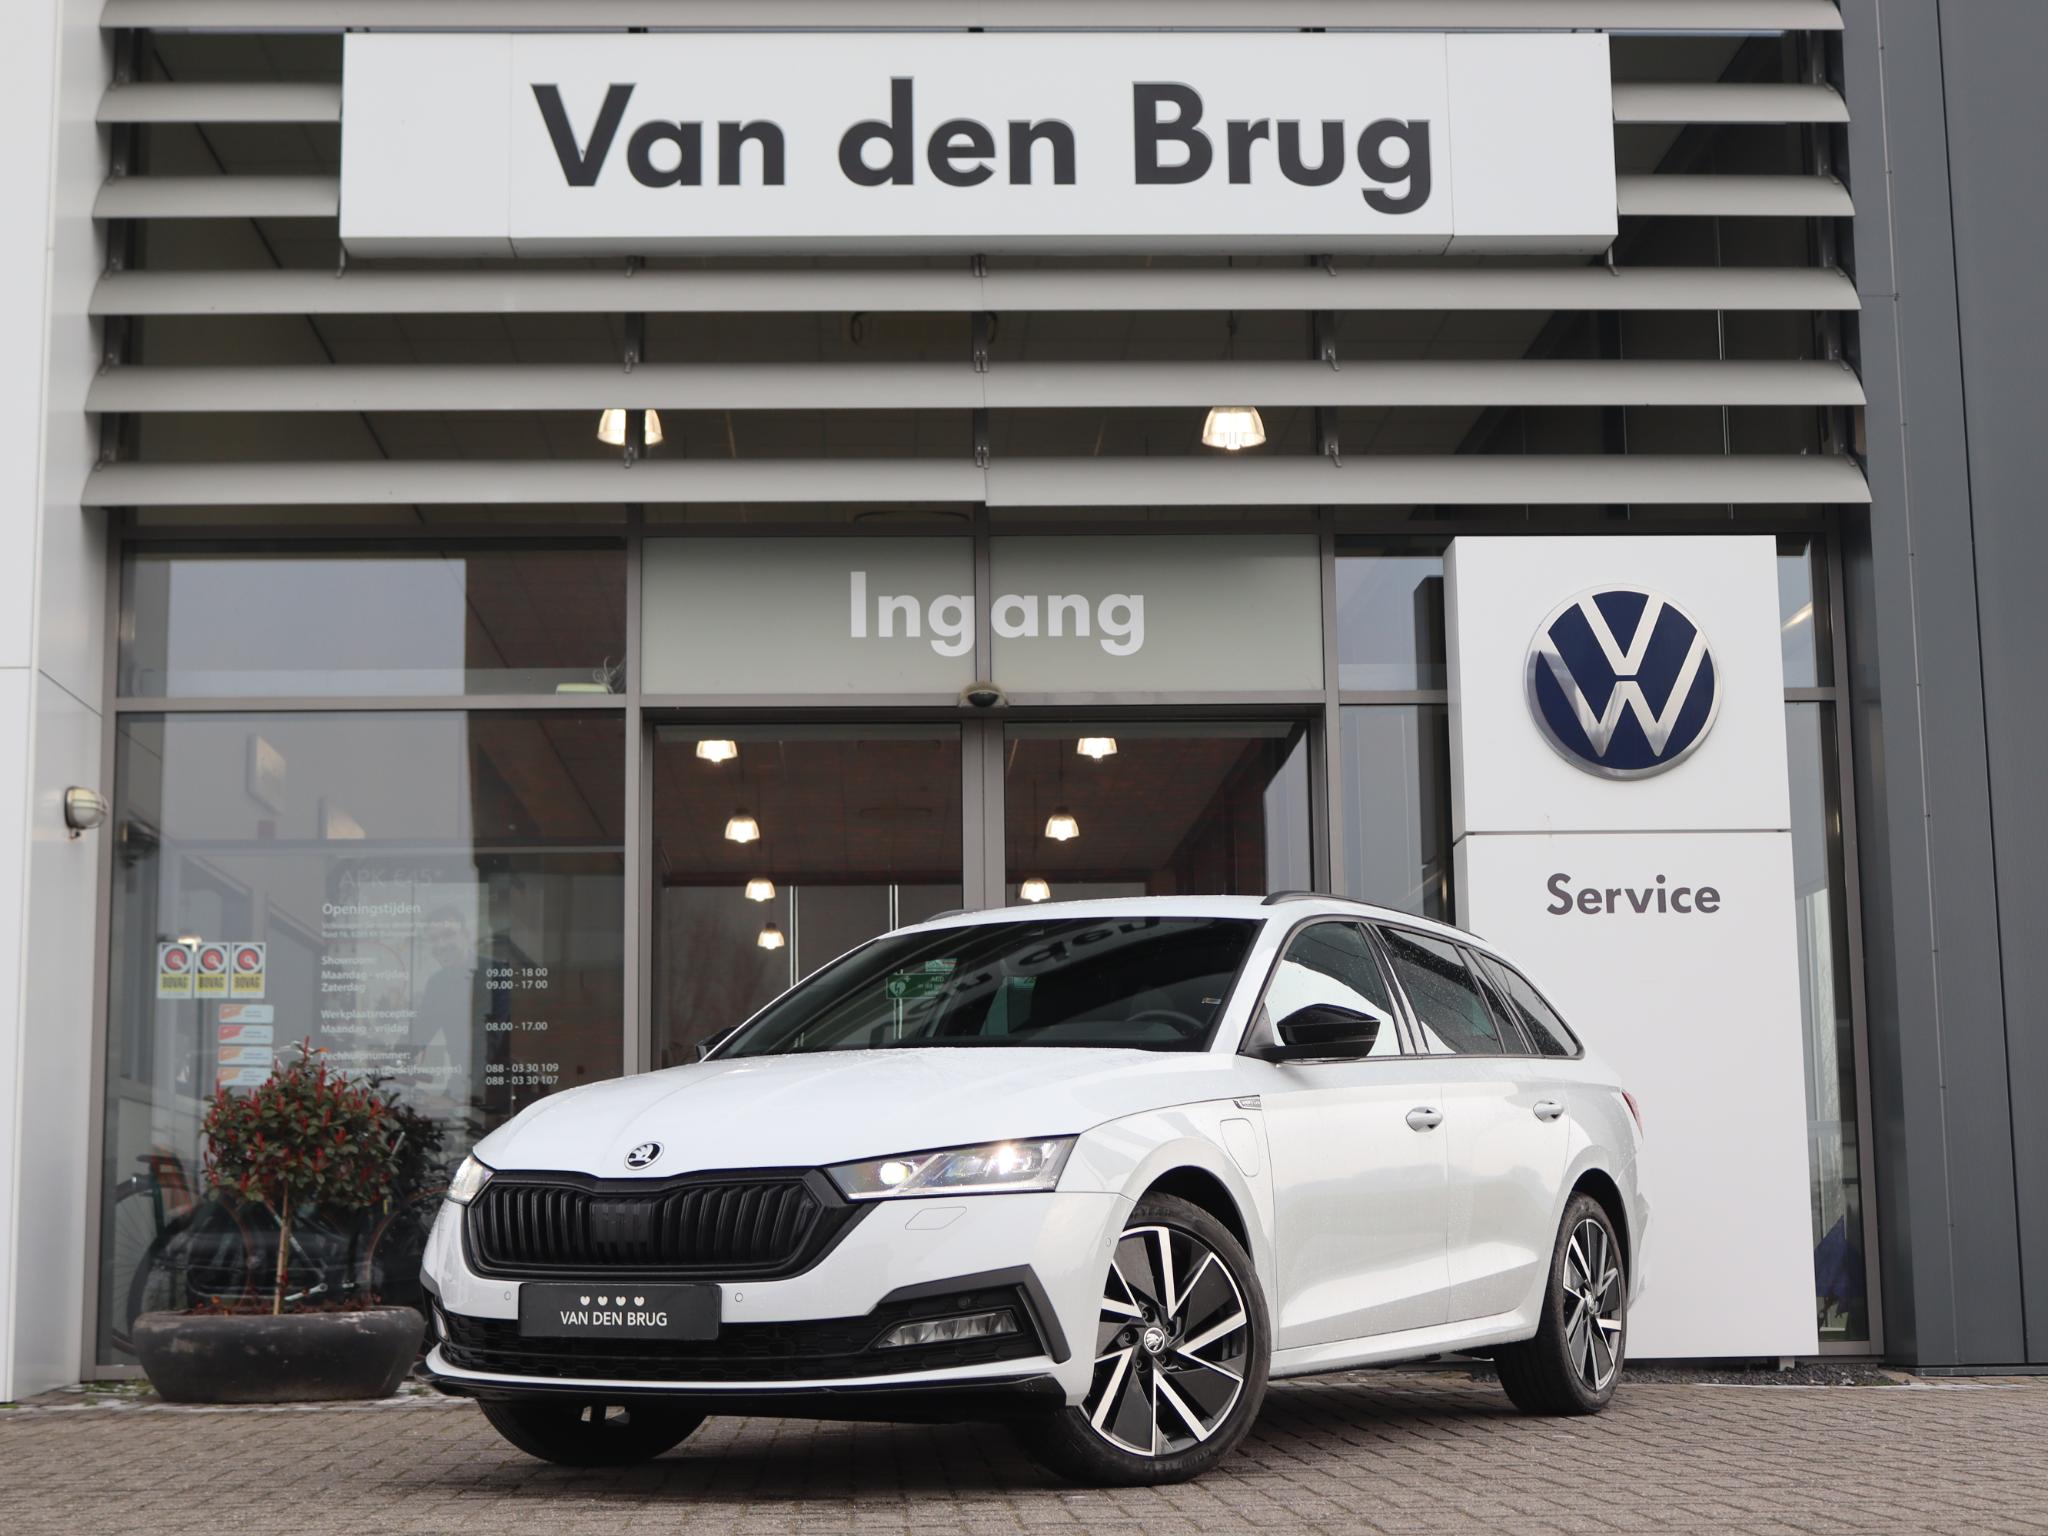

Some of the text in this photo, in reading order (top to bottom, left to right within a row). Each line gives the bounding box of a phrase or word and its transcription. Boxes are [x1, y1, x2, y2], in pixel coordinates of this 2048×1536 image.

[530, 76, 1431, 215] Van den Brug
[850, 571, 1145, 657] Ingang
[1546, 872, 1721, 916] Service
[322, 902, 421, 916] Openingstijden
[486, 1022, 513, 1031] 08.00
[521, 1022, 548, 1031] 17.00
[486, 1064, 504, 1073] 088
[541, 1063, 559, 1073] 109
[486, 1076, 504, 1085] 088
[541, 1075, 559, 1085] 107
[560, 1311, 668, 1327] VAN DEN BRUG
